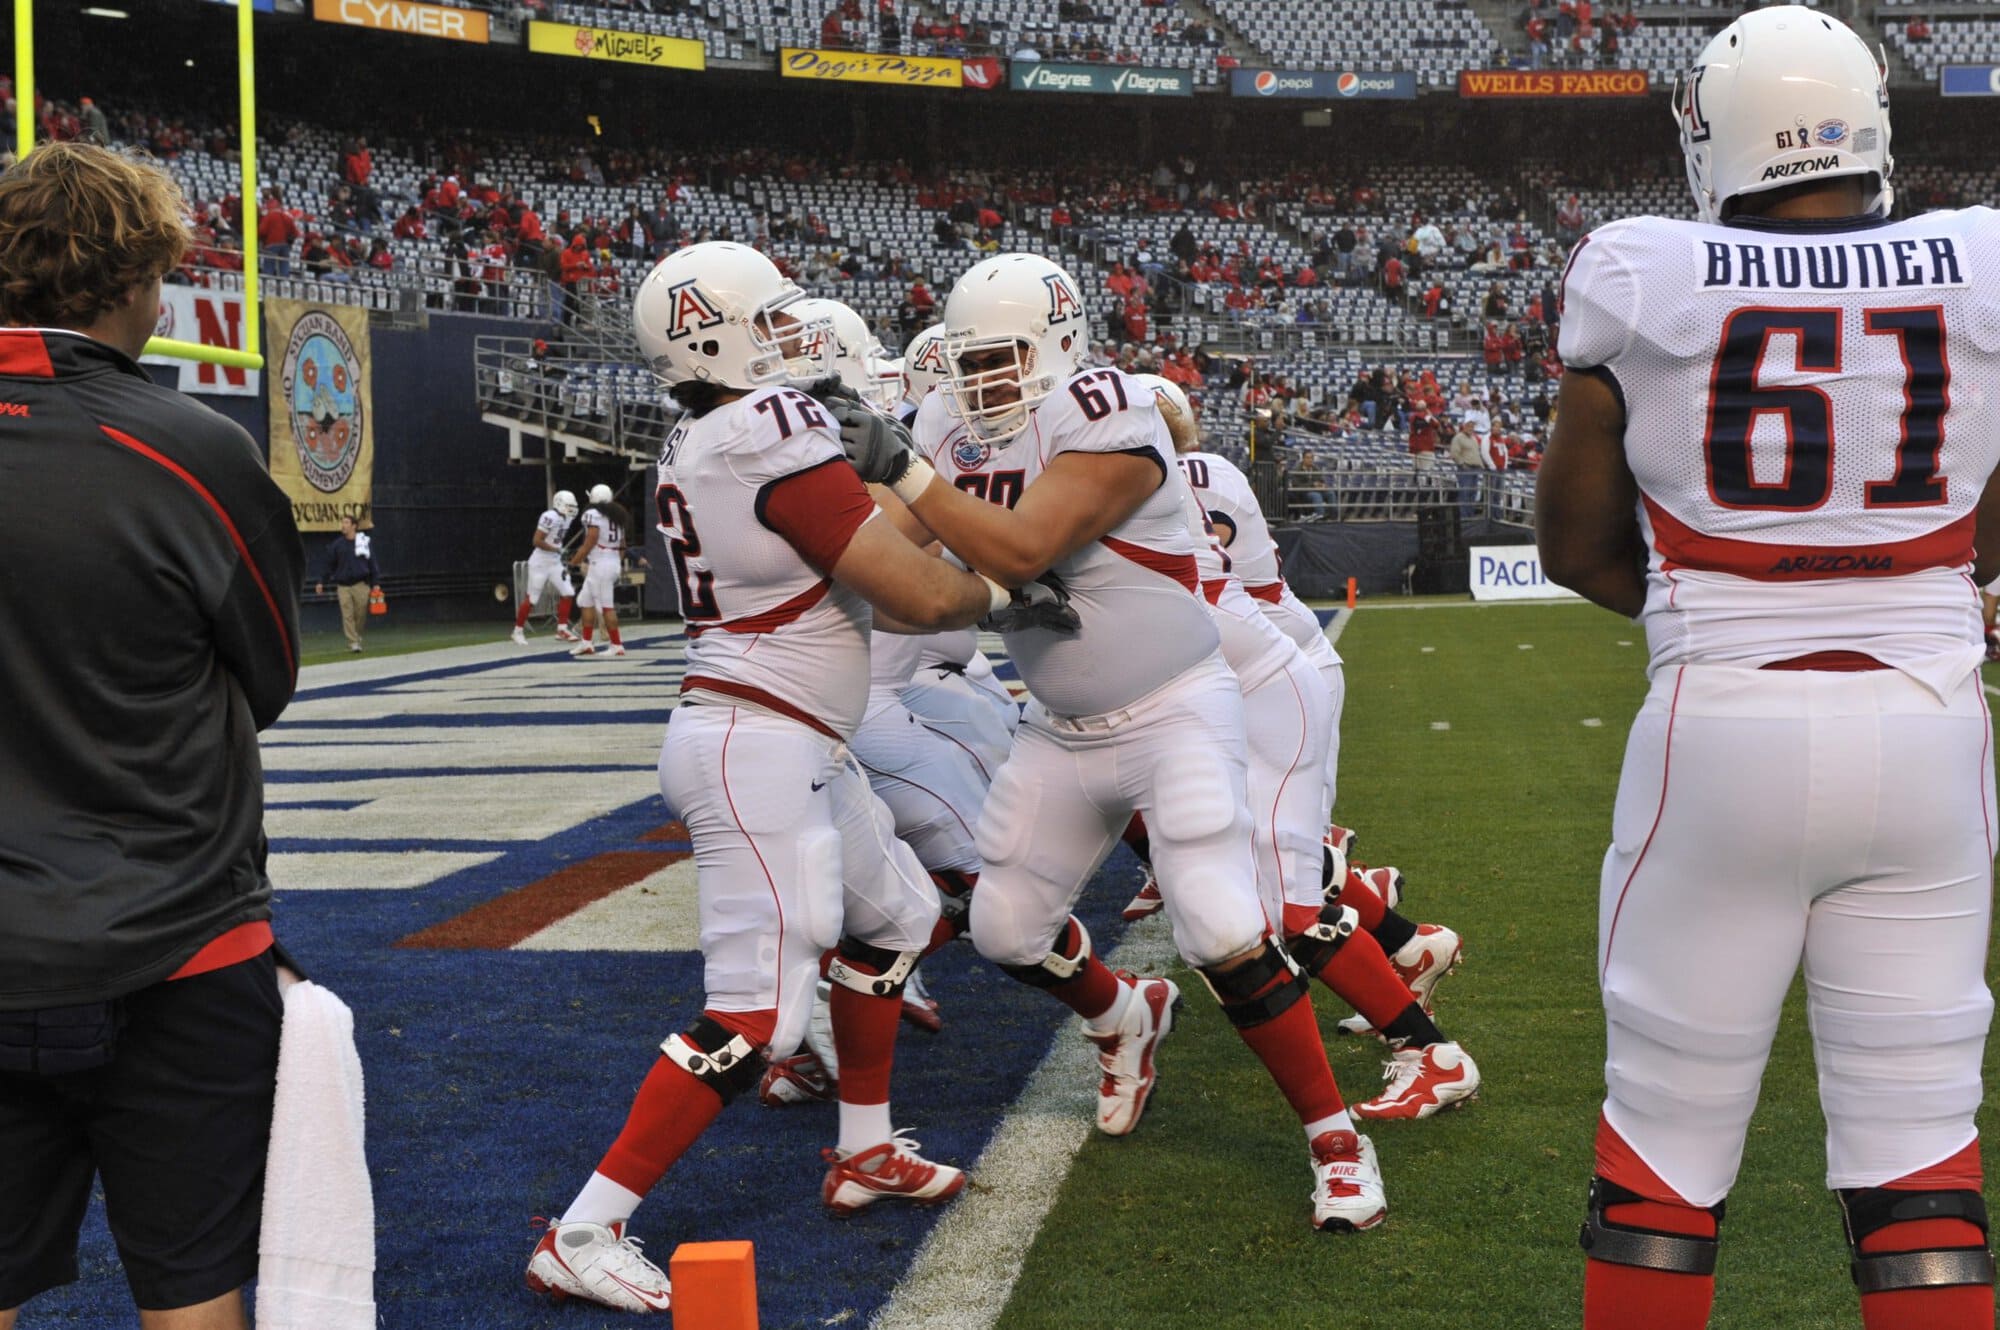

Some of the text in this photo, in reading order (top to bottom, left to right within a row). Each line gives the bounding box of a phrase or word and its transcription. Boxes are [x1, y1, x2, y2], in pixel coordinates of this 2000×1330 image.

[340, 0, 465, 39] CYMER
[787, 51, 955, 82] Oggi's Pizza
[1038, 70, 1094, 89] Degree
[1127, 74, 1181, 93] Degree
[1279, 77, 1314, 89] pepsi
[1360, 79, 1395, 91] pepsi
[1466, 73, 1646, 94] WELLS FARGO
[1775, 130, 1793, 149] 61
[1760, 155, 1840, 181] ARIZONA
[1702, 237, 1964, 289] BROWNER
[666, 278, 724, 341] A
[1042, 273, 1083, 325] A
[195, 298, 247, 386] N
[1068, 371, 1129, 421] 67
[1703, 304, 1952, 513] 61
[753, 391, 828, 440] 72
[1177, 459, 1209, 488] 0
[1479, 556, 1546, 586] PACI
[1768, 555, 1894, 575] ARIZONA
[1329, 1165, 1359, 1176] NIKE
